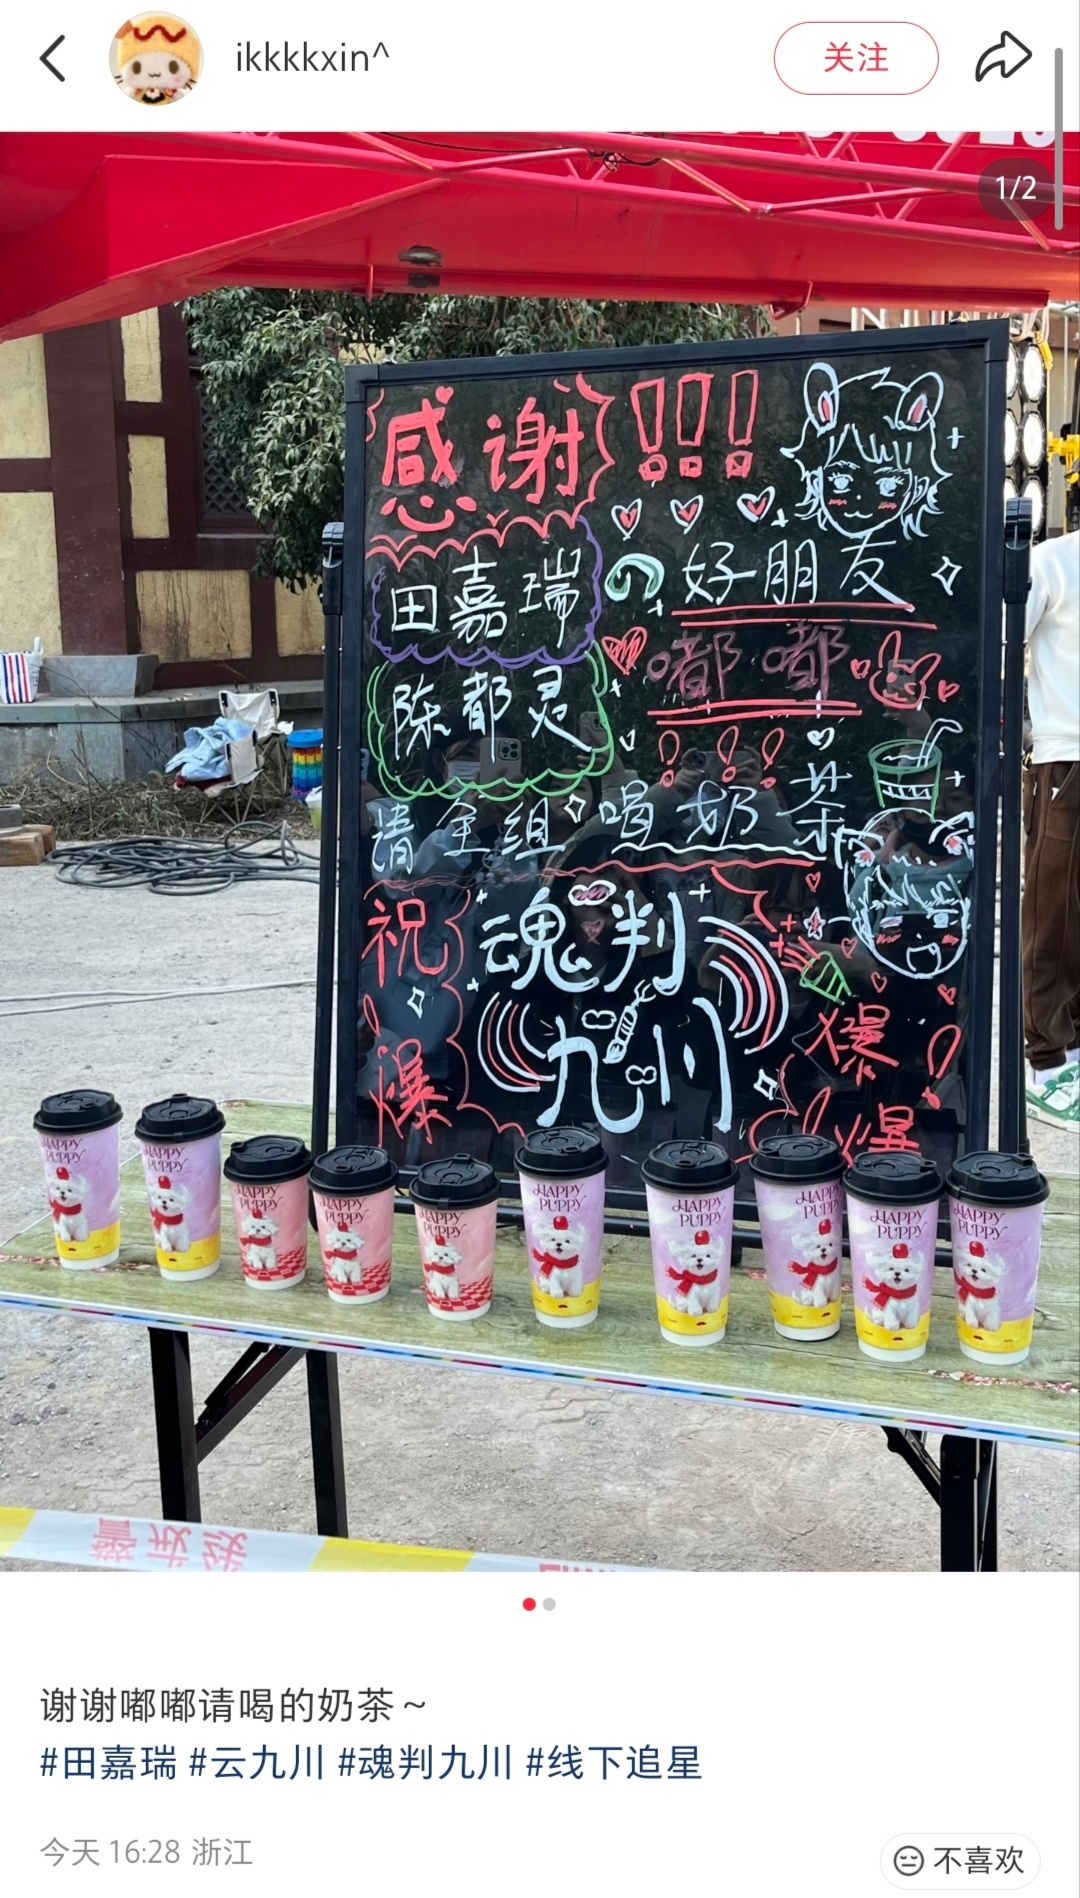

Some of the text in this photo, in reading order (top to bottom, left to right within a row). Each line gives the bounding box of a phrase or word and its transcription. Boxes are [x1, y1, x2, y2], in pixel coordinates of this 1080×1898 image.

[647, 620, 850, 700] 嘟嘟
[392, 665, 592, 764] 陈都灵
[361, 898, 449, 988] 祝
[479, 887, 686, 996] 魂判
[535, 997, 733, 1134] 九川
[42, 1137, 83, 1151] HAPPY
[143, 1145, 185, 1159] HAPPY
[45, 1149, 86, 1164] PUPPY
[147, 1158, 189, 1173] PUPPY
[235, 1184, 280, 1199] HAPPY
[533, 1183, 584, 1199] HAPPY
[795, 1183, 840, 1205] HAPPY
[240, 1196, 283, 1211] PUPPY
[320, 1197, 367, 1212] HAPPY
[539, 1196, 587, 1212] PUPPY
[672, 1196, 725, 1213] HAPPY
[804, 1199, 840, 1219] PUPPY
[325, 1209, 369, 1224] PUPPY
[419, 1208, 464, 1225] HAPPY
[680, 1211, 725, 1228] PUPPY
[870, 1208, 927, 1225] HAPPY
[953, 1203, 1006, 1225] HAPPY
[424, 1222, 467, 1238] PUPPY
[878, 1223, 927, 1240] PUPPY
[958, 1218, 1008, 1240] PUPPY
